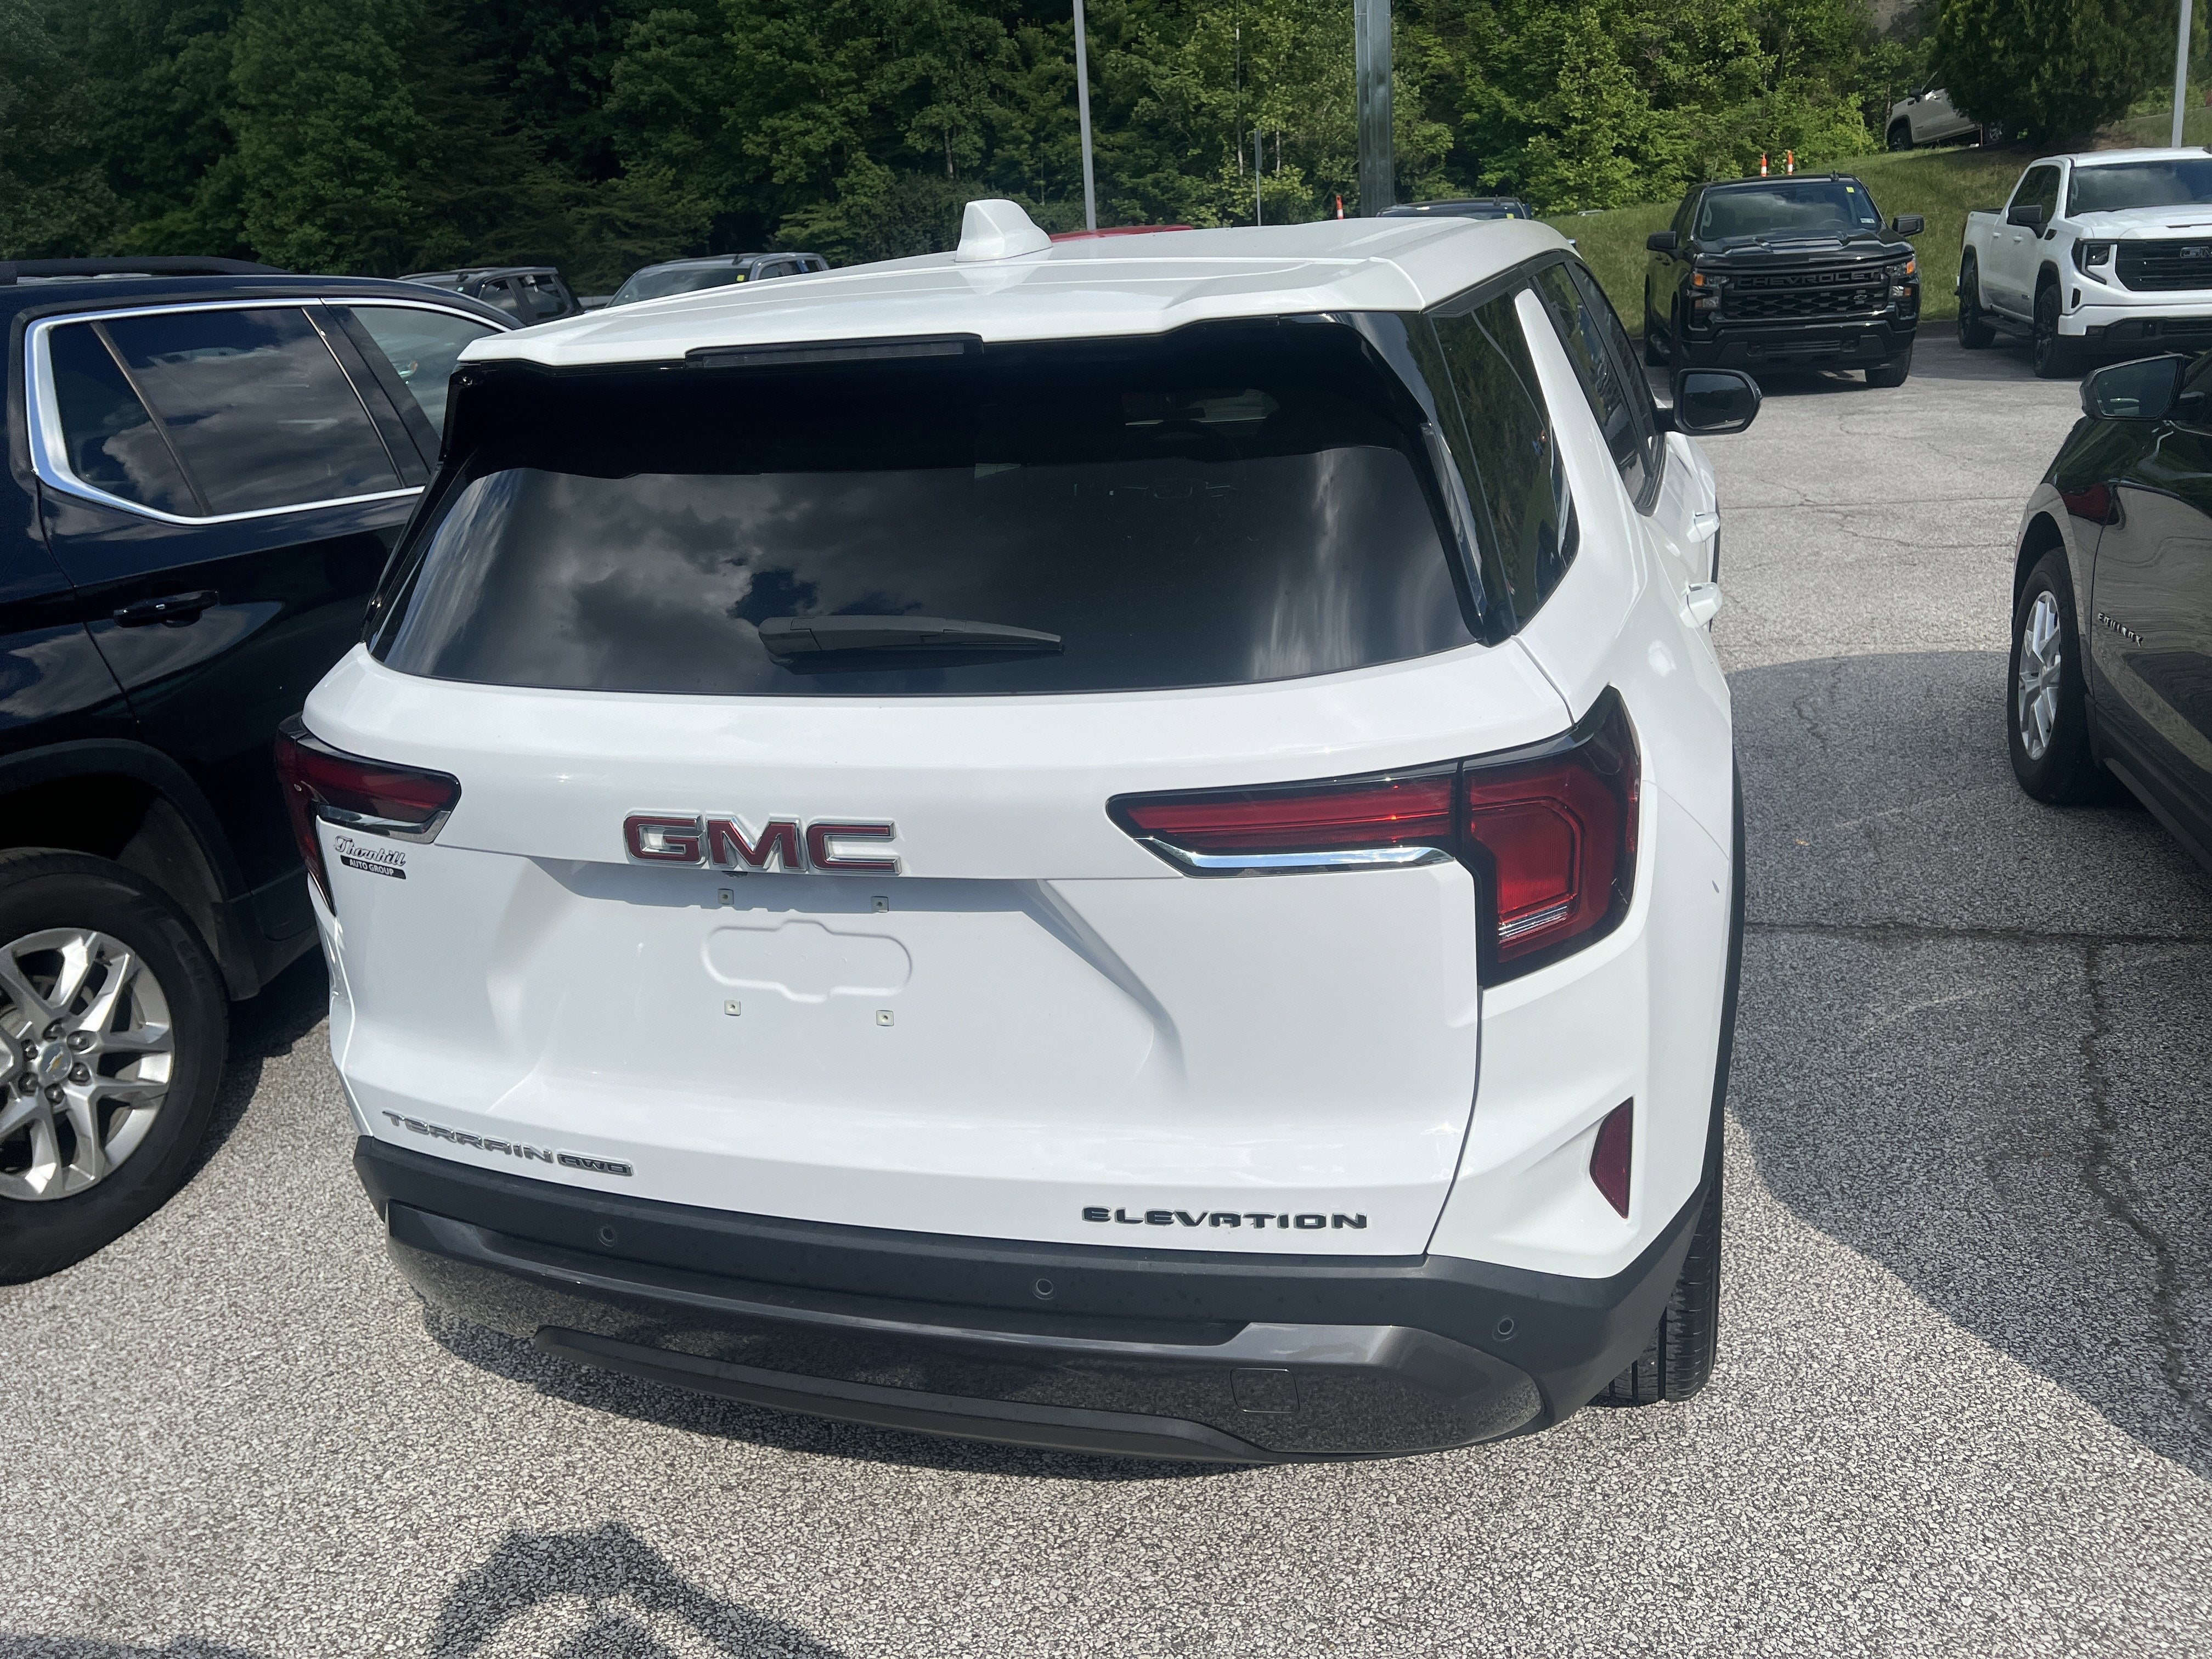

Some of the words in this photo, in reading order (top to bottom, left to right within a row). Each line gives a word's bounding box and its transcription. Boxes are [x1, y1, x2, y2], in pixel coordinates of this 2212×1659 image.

[1737, 269, 1882, 286] CHEVROLET
[334, 836, 406, 866] Thornhill
[624, 810, 902, 876] GMC
[349, 859, 368, 870] AUTO
[369, 864, 394, 876] GROUP
[382, 1109, 554, 1164] TERRAIN
[558, 1154, 633, 1176] AWD
[1081, 1205, 1367, 1229] ELEVATION
